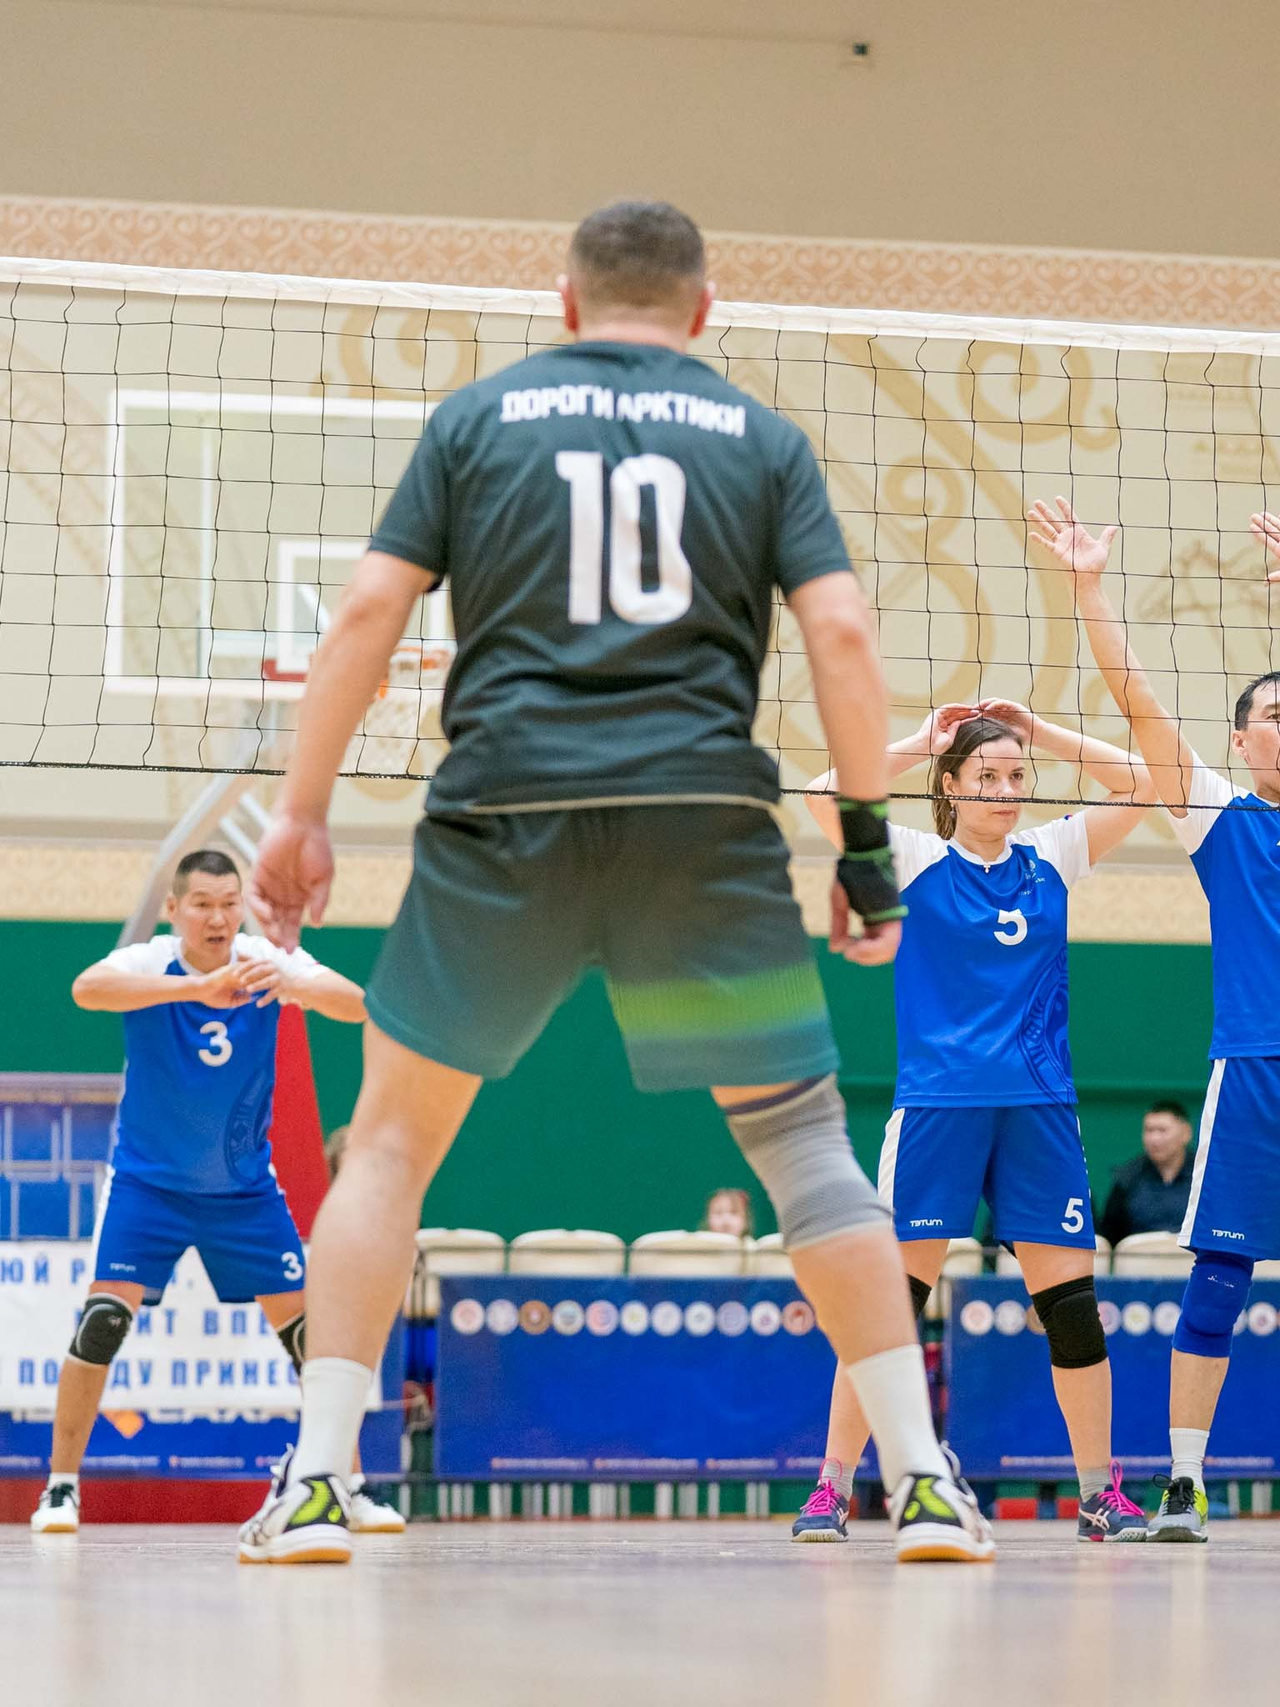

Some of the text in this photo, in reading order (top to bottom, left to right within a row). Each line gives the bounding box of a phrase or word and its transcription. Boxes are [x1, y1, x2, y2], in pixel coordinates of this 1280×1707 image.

[500, 384, 746, 438] ДОРОГИ АРКТИКИ
[555, 451, 693, 624] 10
[993, 908, 1028, 946] 5
[198, 1020, 233, 1067] 3
[1060, 1197, 1084, 1234] 5
[281, 1251, 304, 1281] 3
[19, 1359, 153, 1389] ПОДУ
